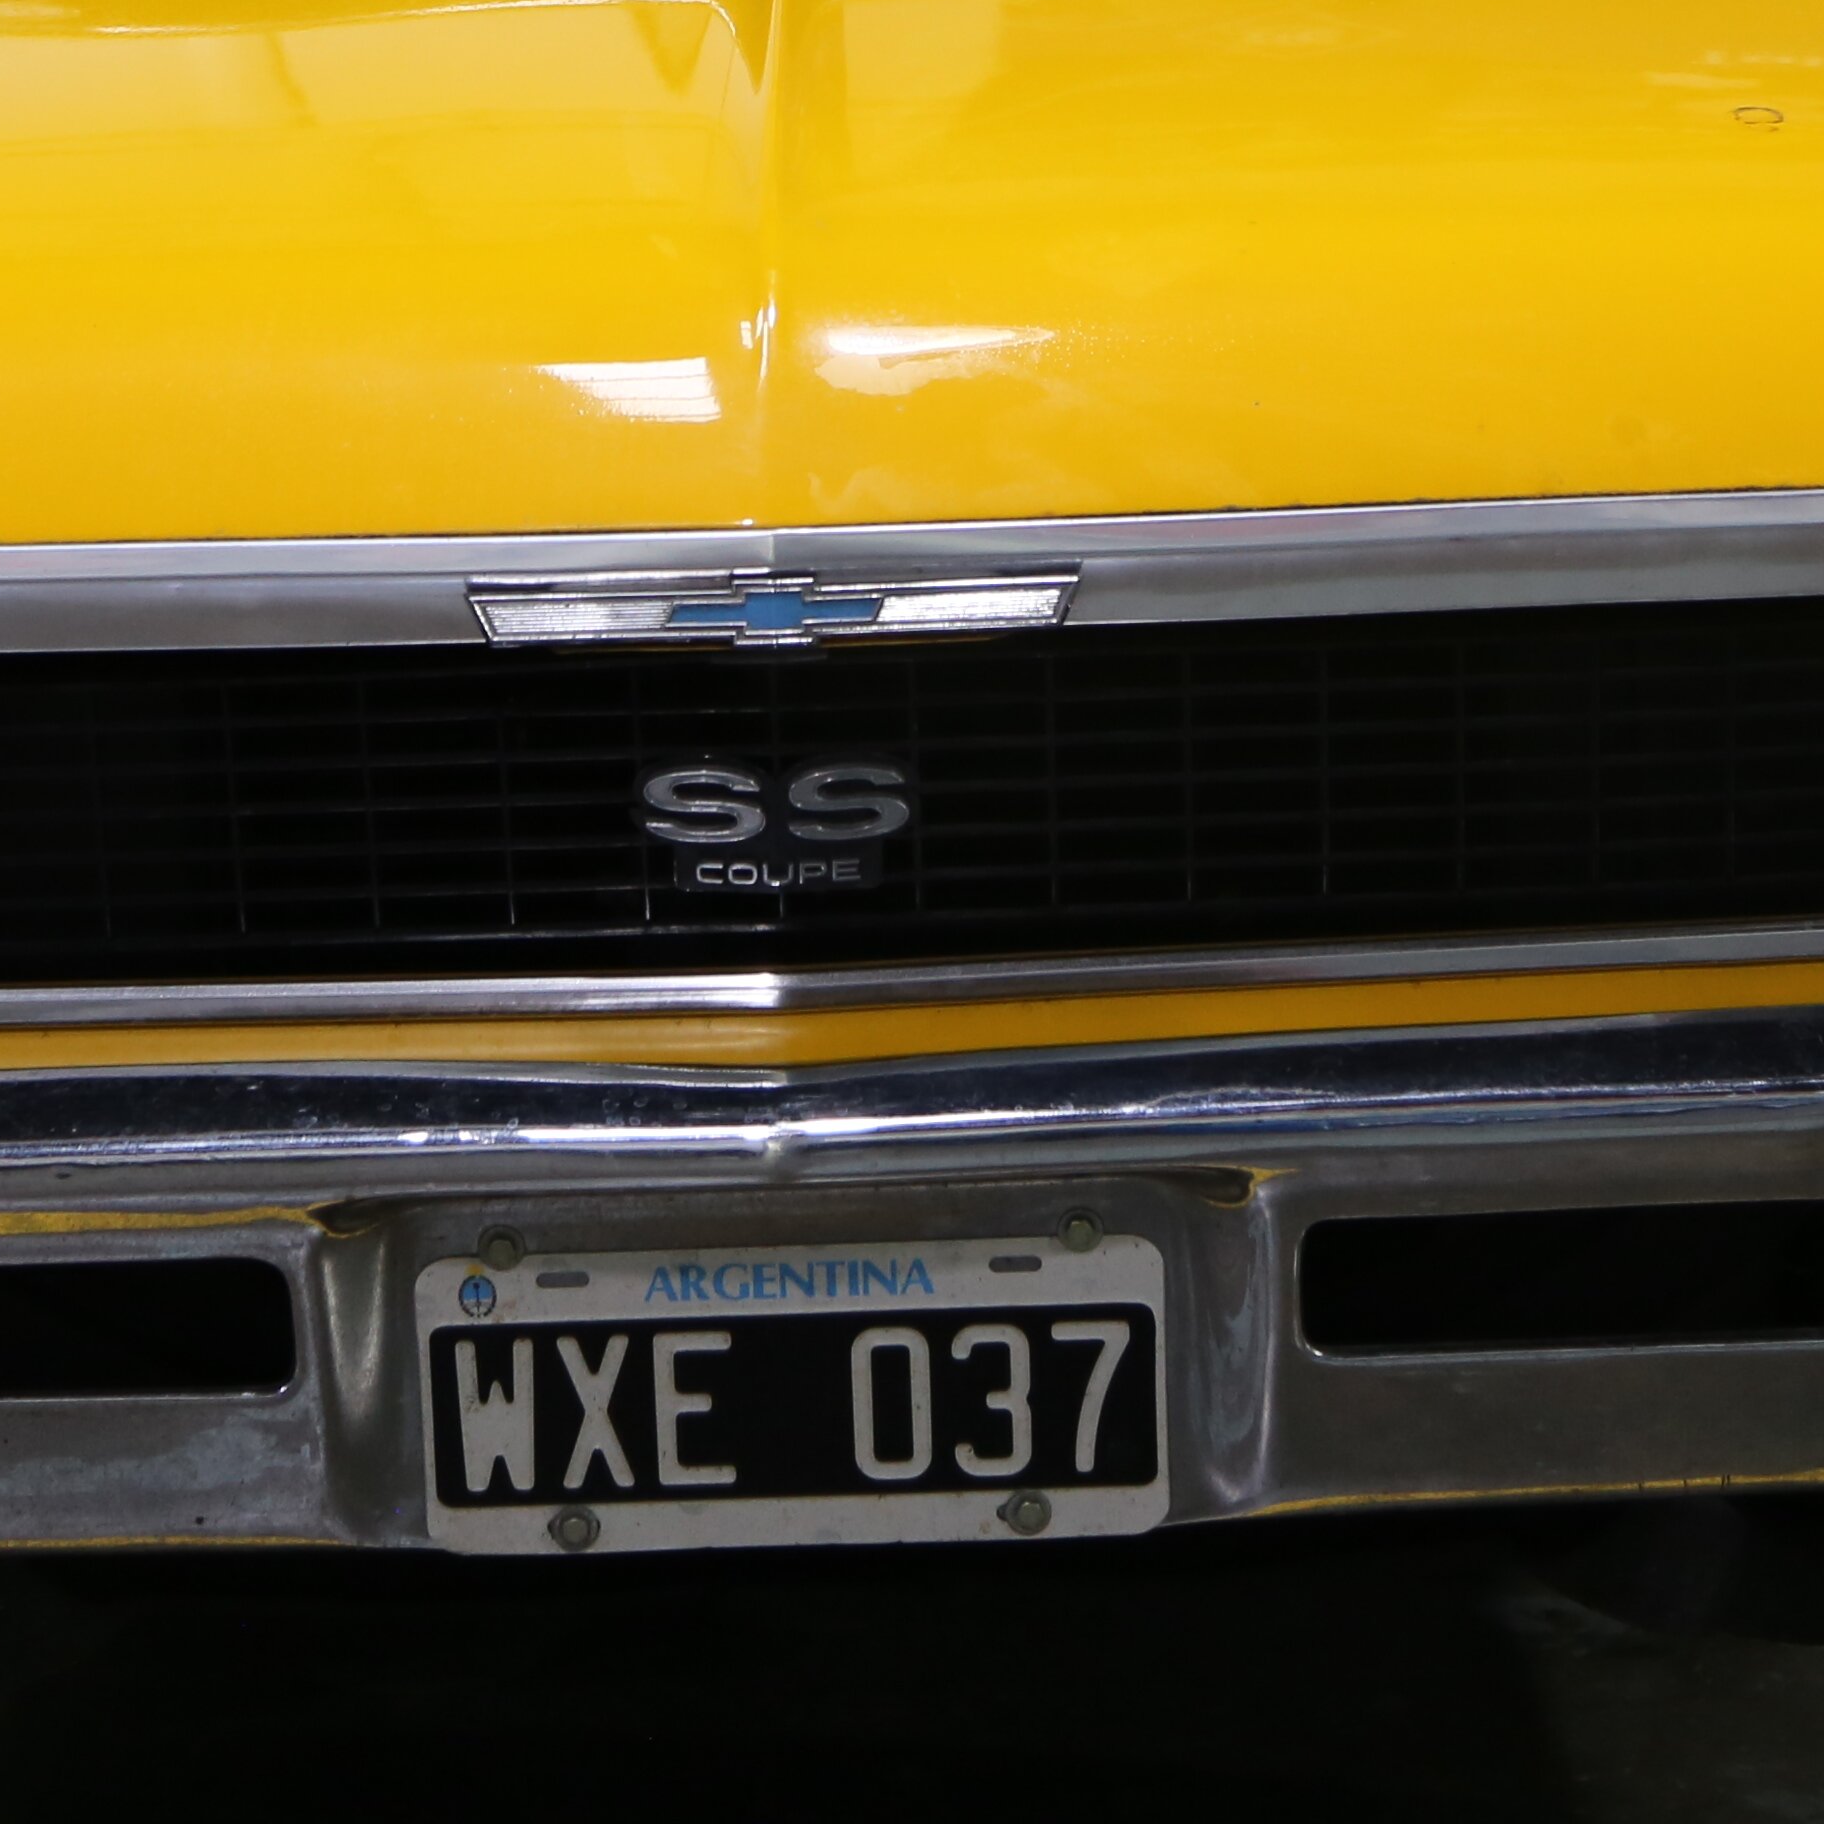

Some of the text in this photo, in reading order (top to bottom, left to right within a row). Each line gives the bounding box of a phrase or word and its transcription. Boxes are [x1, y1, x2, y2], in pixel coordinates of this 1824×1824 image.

[643, 766, 910, 841] SS
[695, 858, 862, 886] COUPE
[644, 1258, 936, 1304] ARGENTINA
[454, 1319, 1132, 1493] WXE 037
